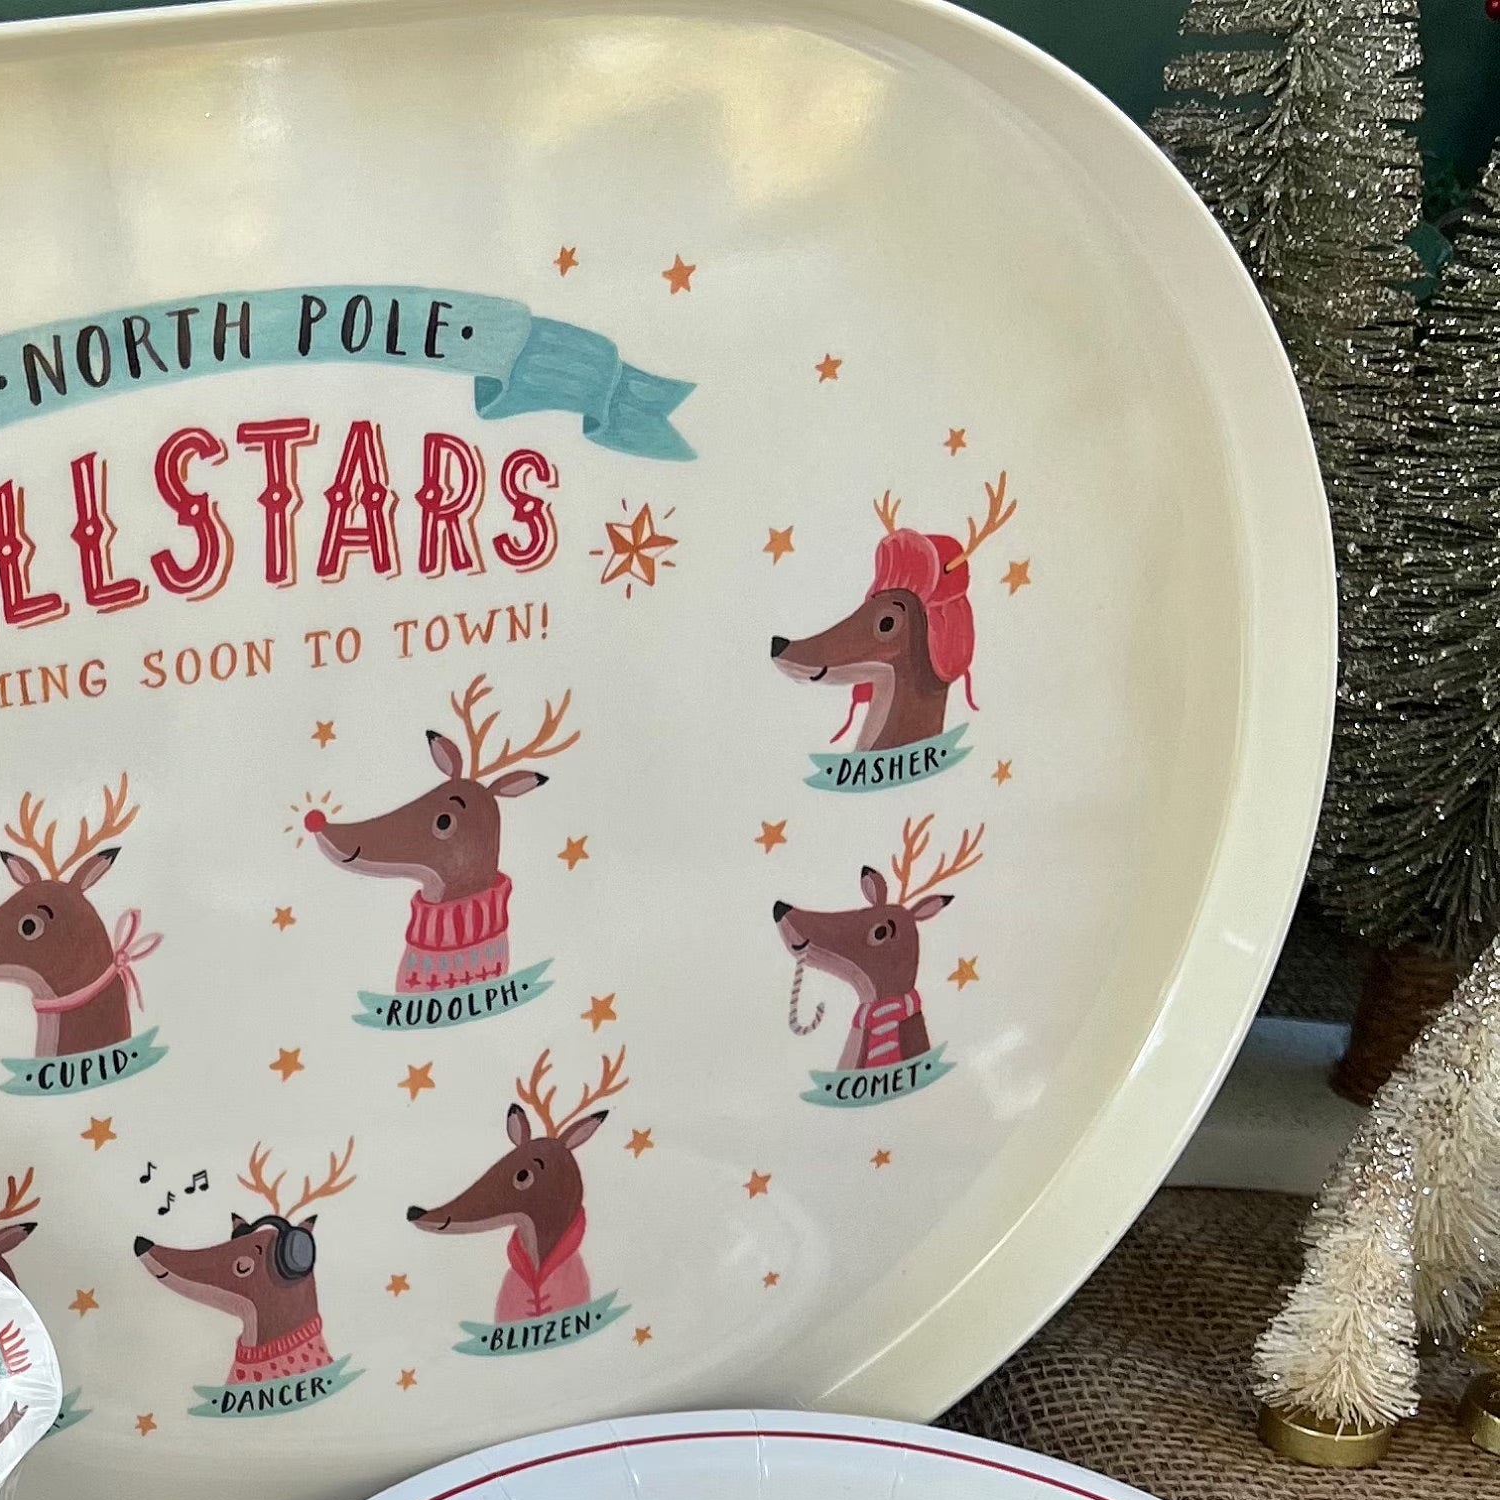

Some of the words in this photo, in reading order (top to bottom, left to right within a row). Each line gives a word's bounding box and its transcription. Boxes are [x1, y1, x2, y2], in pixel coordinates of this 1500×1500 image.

[22, 300, 252, 406] NORTH
[297, 294, 454, 359] POLE
[140, 638, 276, 689] SOON
[304, 626, 363, 669] TO
[393, 602, 550, 659] TOWN!
[836, 747, 939, 787] DASHER
[386, 983, 520, 1028] RUDOLPH
[37, 1047, 130, 1092] CUPID
[836, 1063, 921, 1100] COMET
[489, 1309, 593, 1352] BLITZEN
[220, 1373, 328, 1415] DANCER
